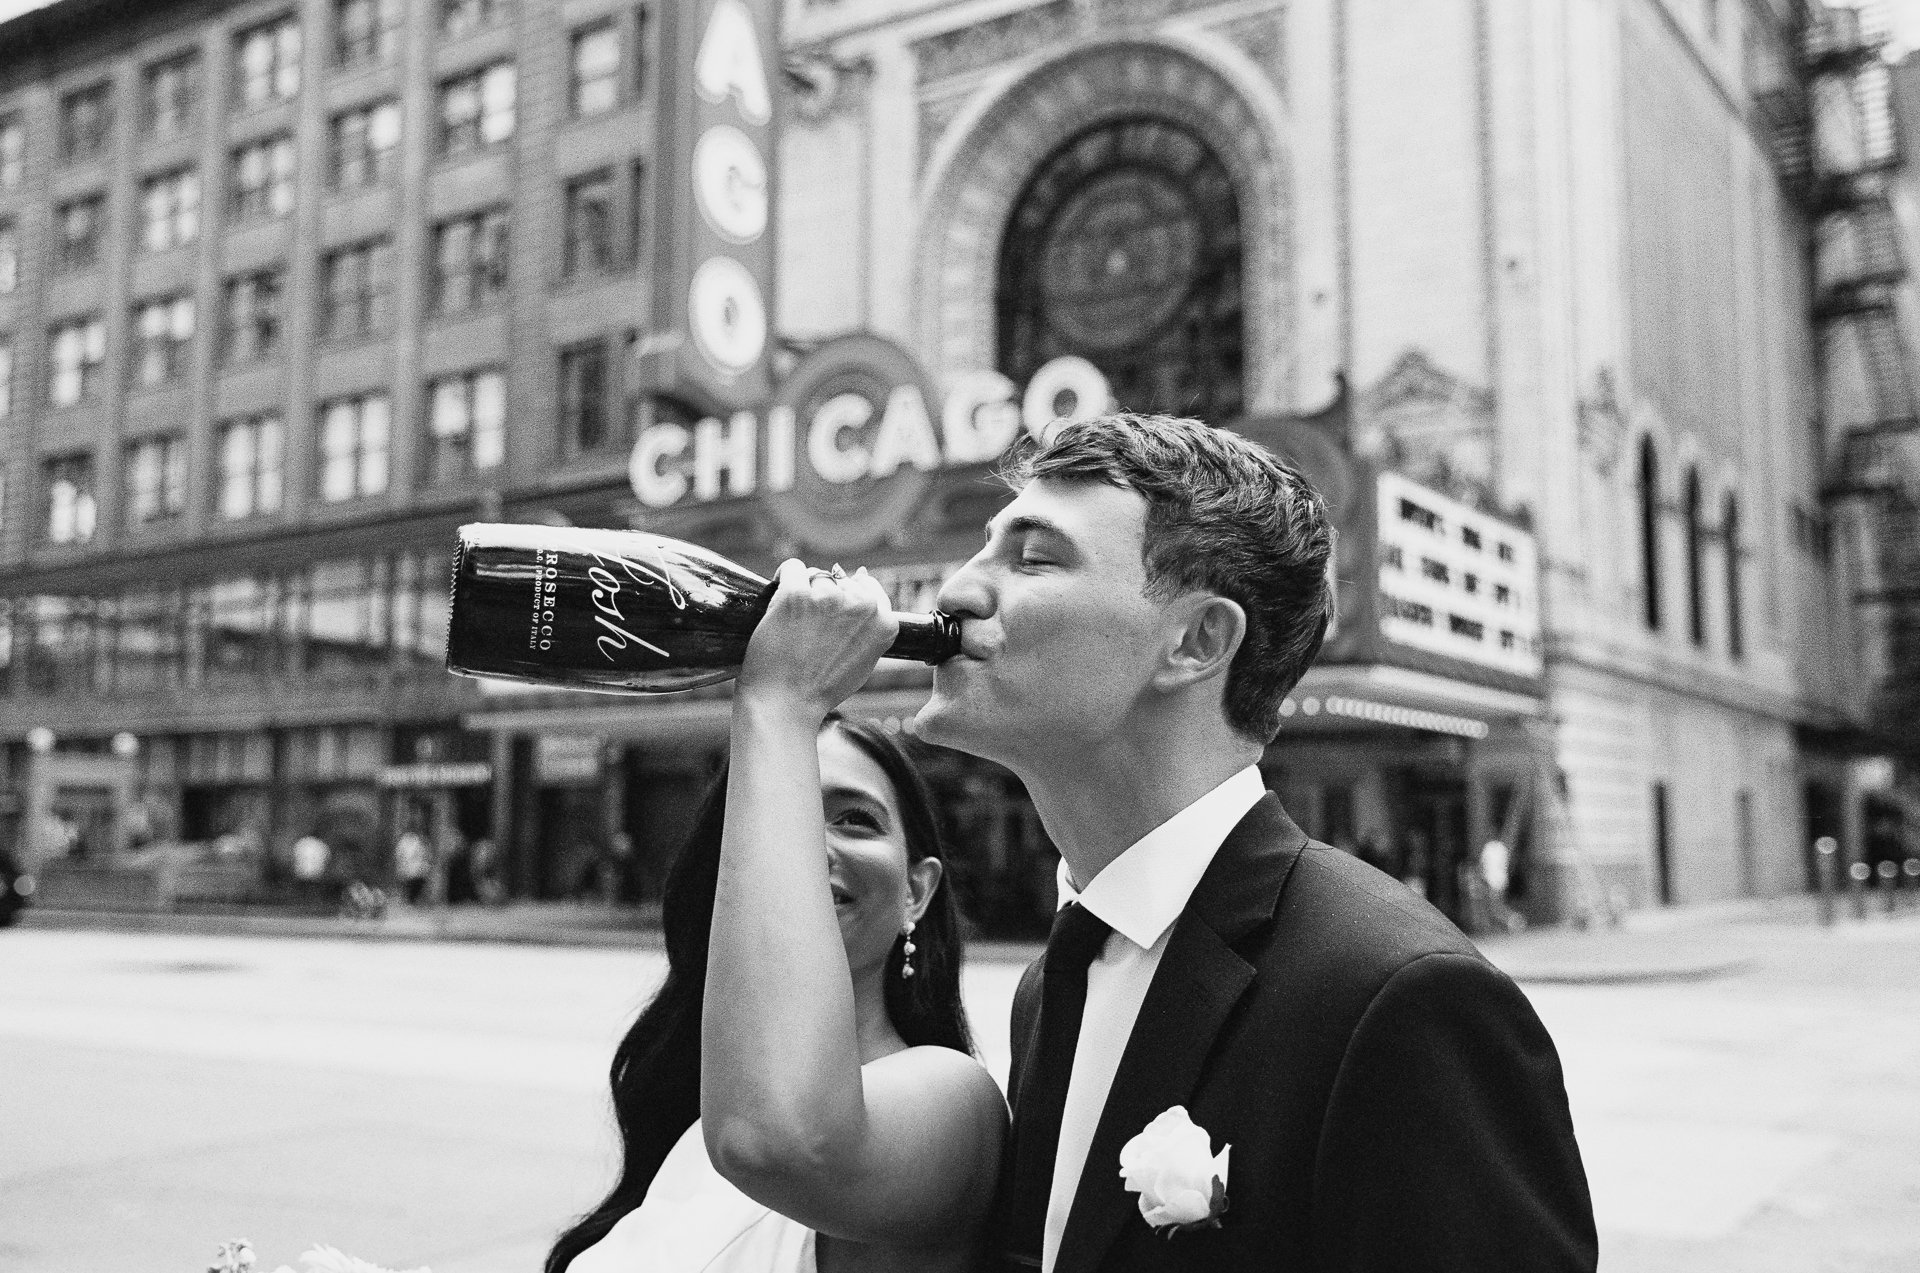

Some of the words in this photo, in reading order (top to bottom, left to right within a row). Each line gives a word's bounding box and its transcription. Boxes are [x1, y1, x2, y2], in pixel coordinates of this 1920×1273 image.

[629, 355, 1112, 508] CHICAGO
[532, 612, 540, 624] OF
[533, 569, 543, 610] PRODUCT
[540, 546, 559, 651] ROSECCO
[582, 545, 686, 662] Josh
[529, 626, 538, 650] ITALY
